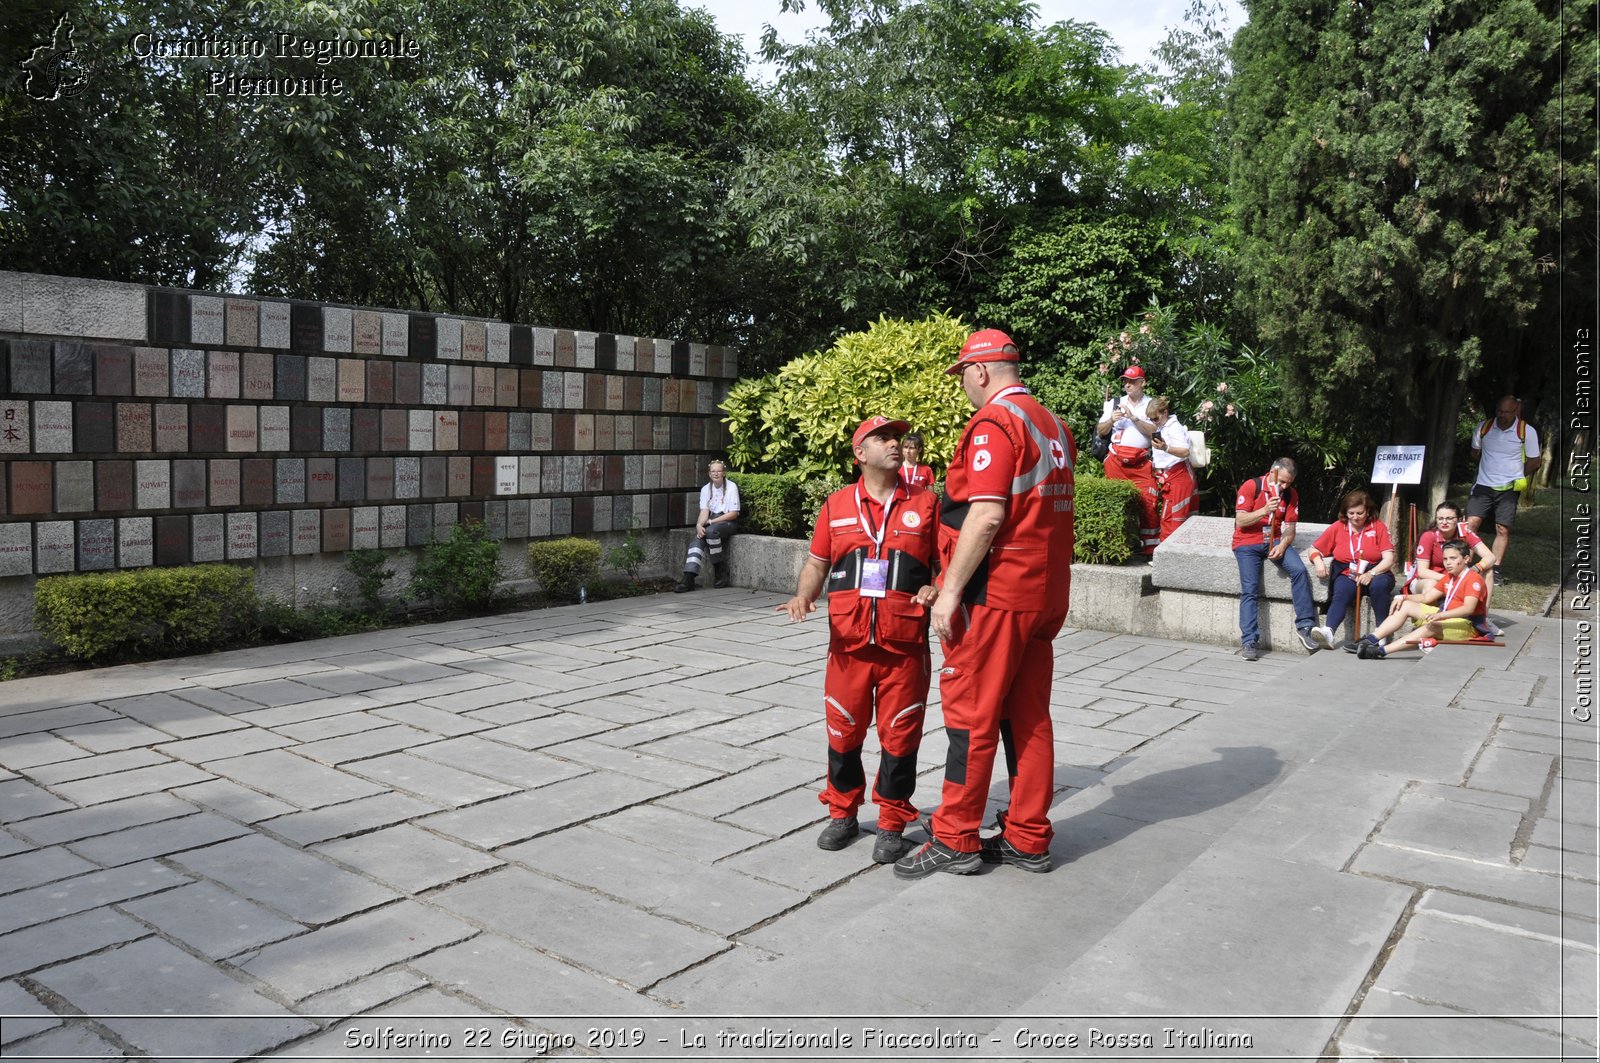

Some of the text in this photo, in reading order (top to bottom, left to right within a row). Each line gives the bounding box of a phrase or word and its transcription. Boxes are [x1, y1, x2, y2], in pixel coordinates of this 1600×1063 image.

[245, 379, 272, 390] INDIA
[3, 408, 21, 443] 日本
[229, 430, 256, 438] URUGUAY
[1377, 453, 1422, 461] CERMENATE
[1388, 467, 1406, 476] (CO)
[16, 482, 49, 491] MONACO
[140, 481, 168, 489] KUWAIT
